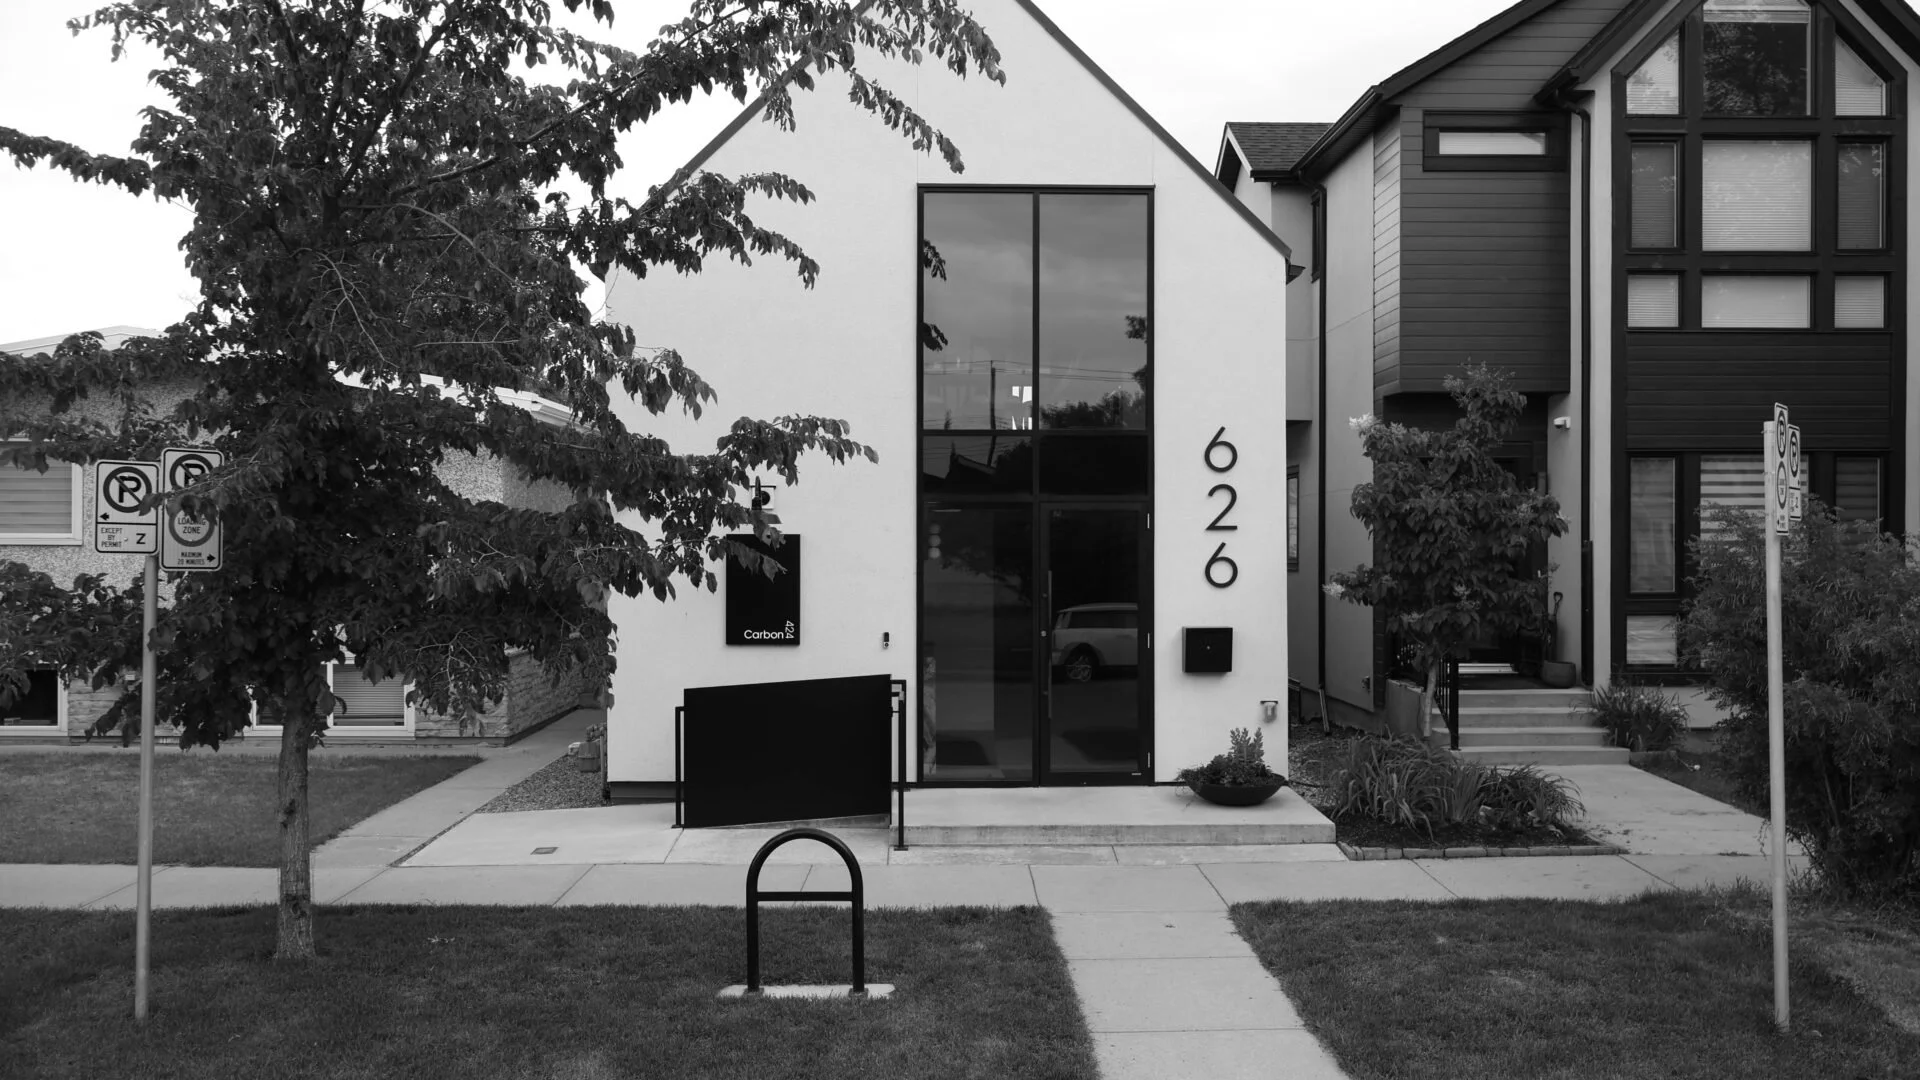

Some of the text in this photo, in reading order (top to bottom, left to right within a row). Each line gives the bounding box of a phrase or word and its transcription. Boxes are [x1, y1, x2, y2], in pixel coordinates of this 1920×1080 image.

[1204, 426, 1238, 588] 626
[177, 516, 207, 526] LOAG
[100, 527, 123, 535] EXCEPT
[182, 526, 201, 535] ZONE
[136, 533, 146, 545] Z
[743, 620, 795, 639] Carbon 424
